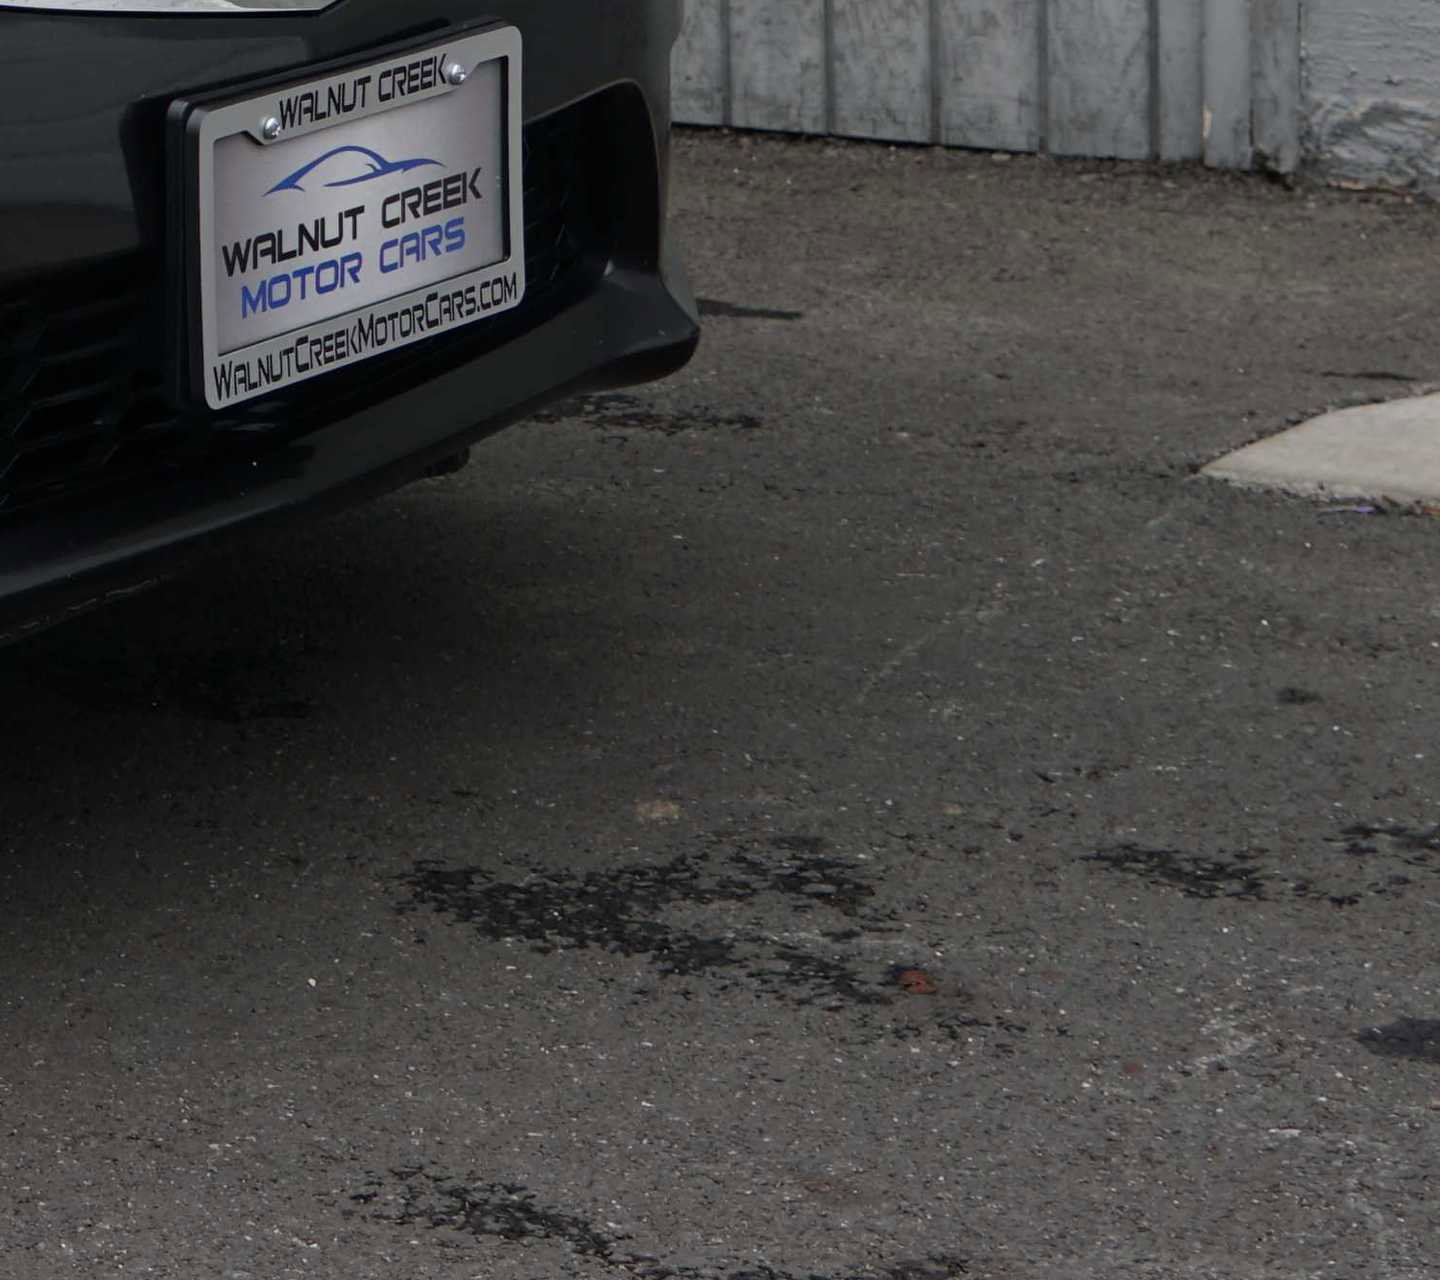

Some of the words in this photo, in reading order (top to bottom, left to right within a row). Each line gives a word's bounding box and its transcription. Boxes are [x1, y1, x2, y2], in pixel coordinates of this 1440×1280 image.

[279, 74, 370, 130] WALNUT
[378, 54, 446, 101] CREEK
[222, 205, 364, 277] WALNUT
[381, 168, 482, 229] CREEK
[241, 252, 361, 319] MOTOR
[379, 217, 465, 273] CARS
